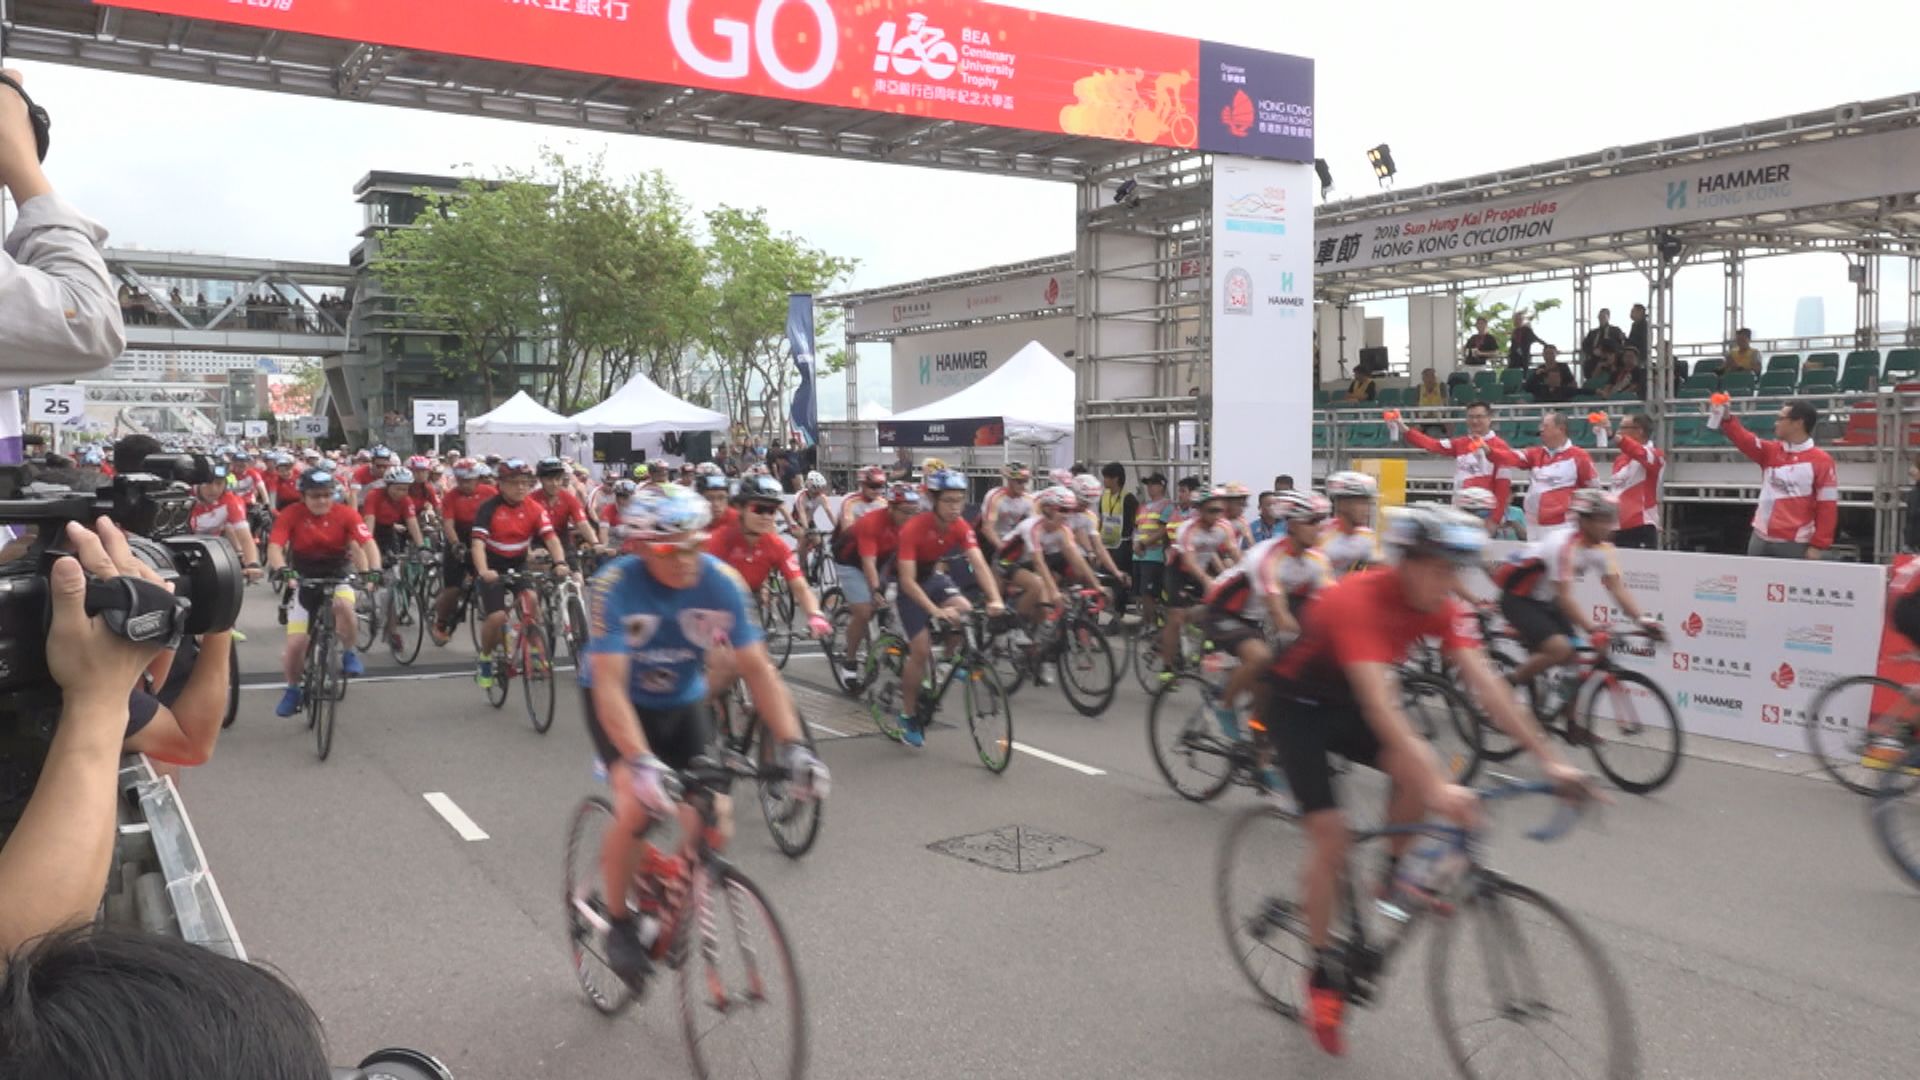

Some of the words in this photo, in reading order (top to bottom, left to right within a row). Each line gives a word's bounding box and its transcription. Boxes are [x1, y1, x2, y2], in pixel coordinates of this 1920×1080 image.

[668, 0, 838, 89] GO
[961, 27, 991, 45] BEA
[961, 45, 1015, 64] Centenary
[961, 59, 1015, 79] University
[961, 73, 998, 90] Trophy
[1258, 101, 1285, 113] HONG
[1286, 104, 1312, 117] KONG
[1698, 163, 1790, 193] HAMMER
[1697, 193, 1741, 208] HONG
[1745, 183, 1792, 202] KONG
[1374, 225, 1400, 241] 2018
[1403, 221, 1426, 237] Sun
[1428, 216, 1460, 233] Hung
[1461, 211, 1482, 228] Kai
[1484, 200, 1557, 224] Properties
[1314, 231, 1362, 266] 車節
[1371, 239, 1414, 260] HONG
[1416, 233, 1460, 255] KONG
[1462, 218, 1554, 249] CYCLOTHON
[1268, 296, 1304, 307] HAMMER
[936, 350, 988, 372] HAMMER
[44, 398, 70, 415] 25
[306, 424, 320, 433] 50
[426, 412, 448, 428] 25
[1693, 693, 1743, 712] HAMMER
